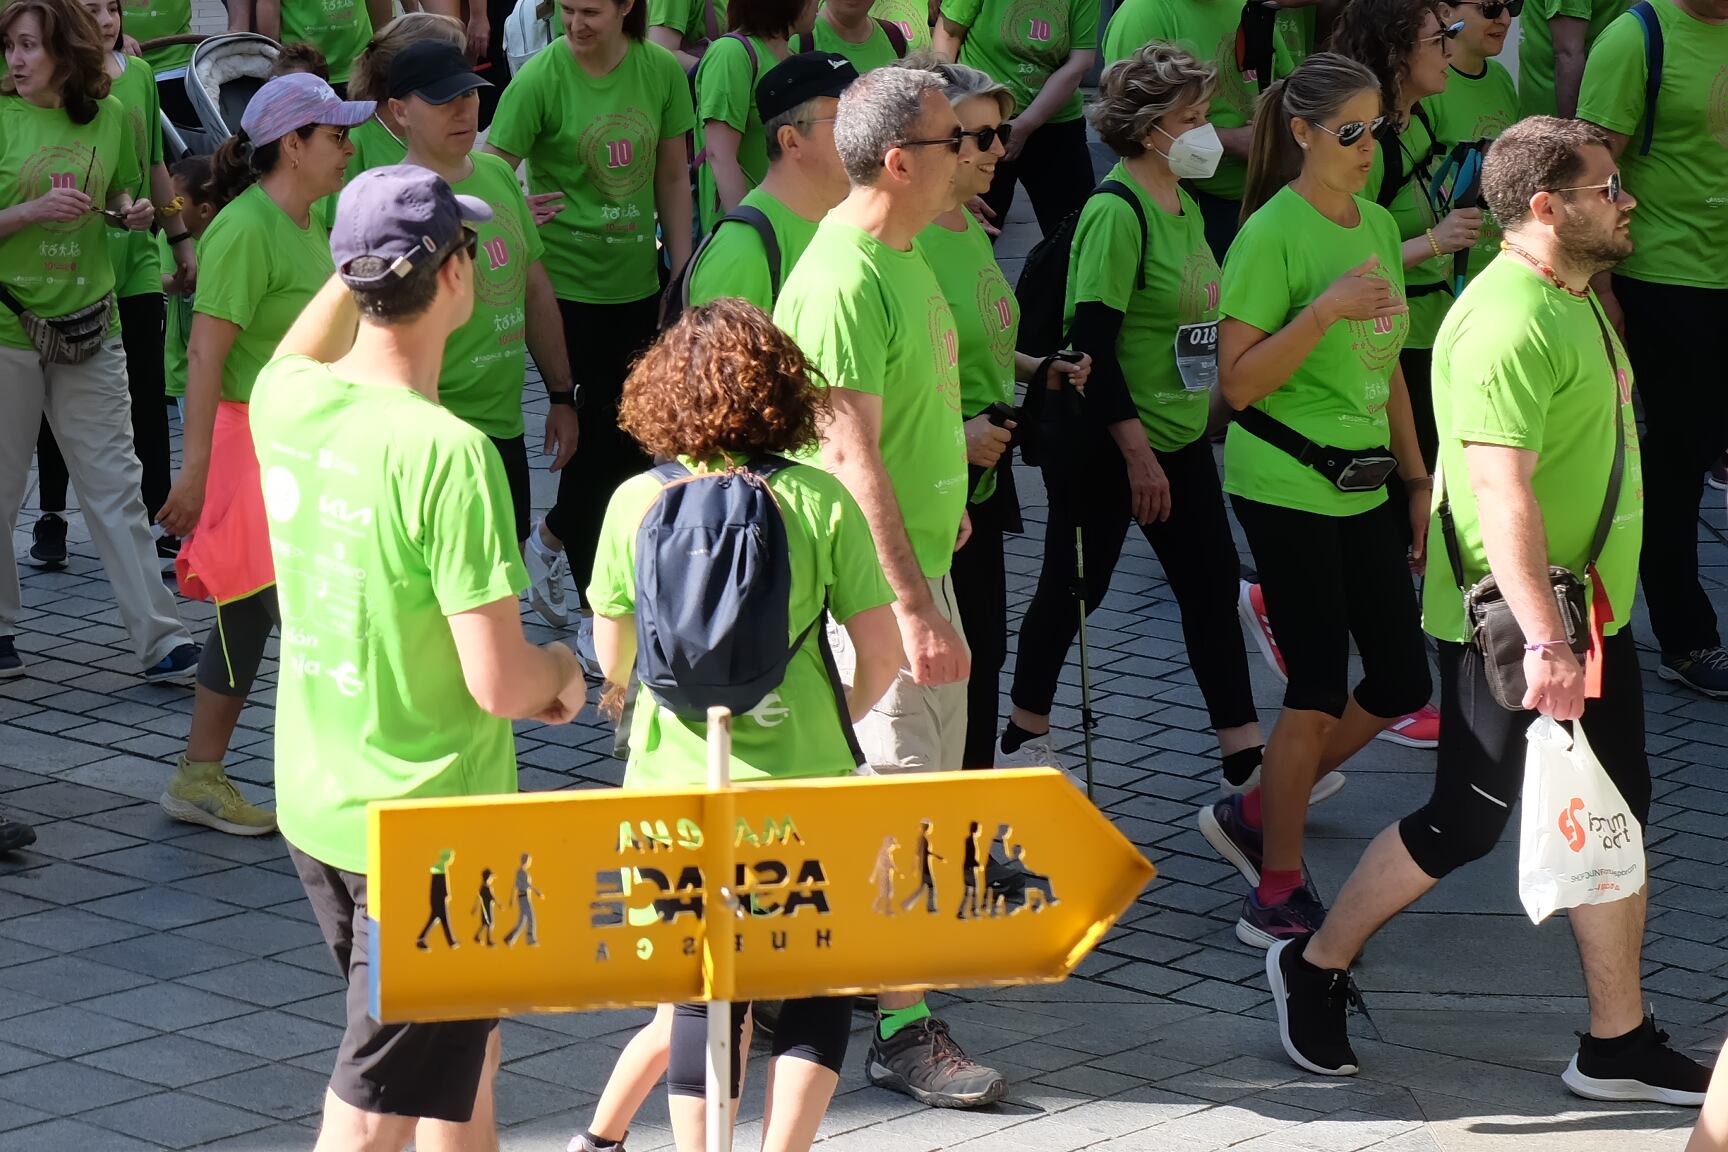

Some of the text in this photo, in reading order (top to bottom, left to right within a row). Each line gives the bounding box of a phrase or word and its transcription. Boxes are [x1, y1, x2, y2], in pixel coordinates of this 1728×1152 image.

[1028, 18, 1052, 41] 10
[606, 139, 633, 169] 10
[482, 236, 509, 271] 10
[1189, 326, 1218, 345] 018
[1372, 314, 1393, 336] 10
